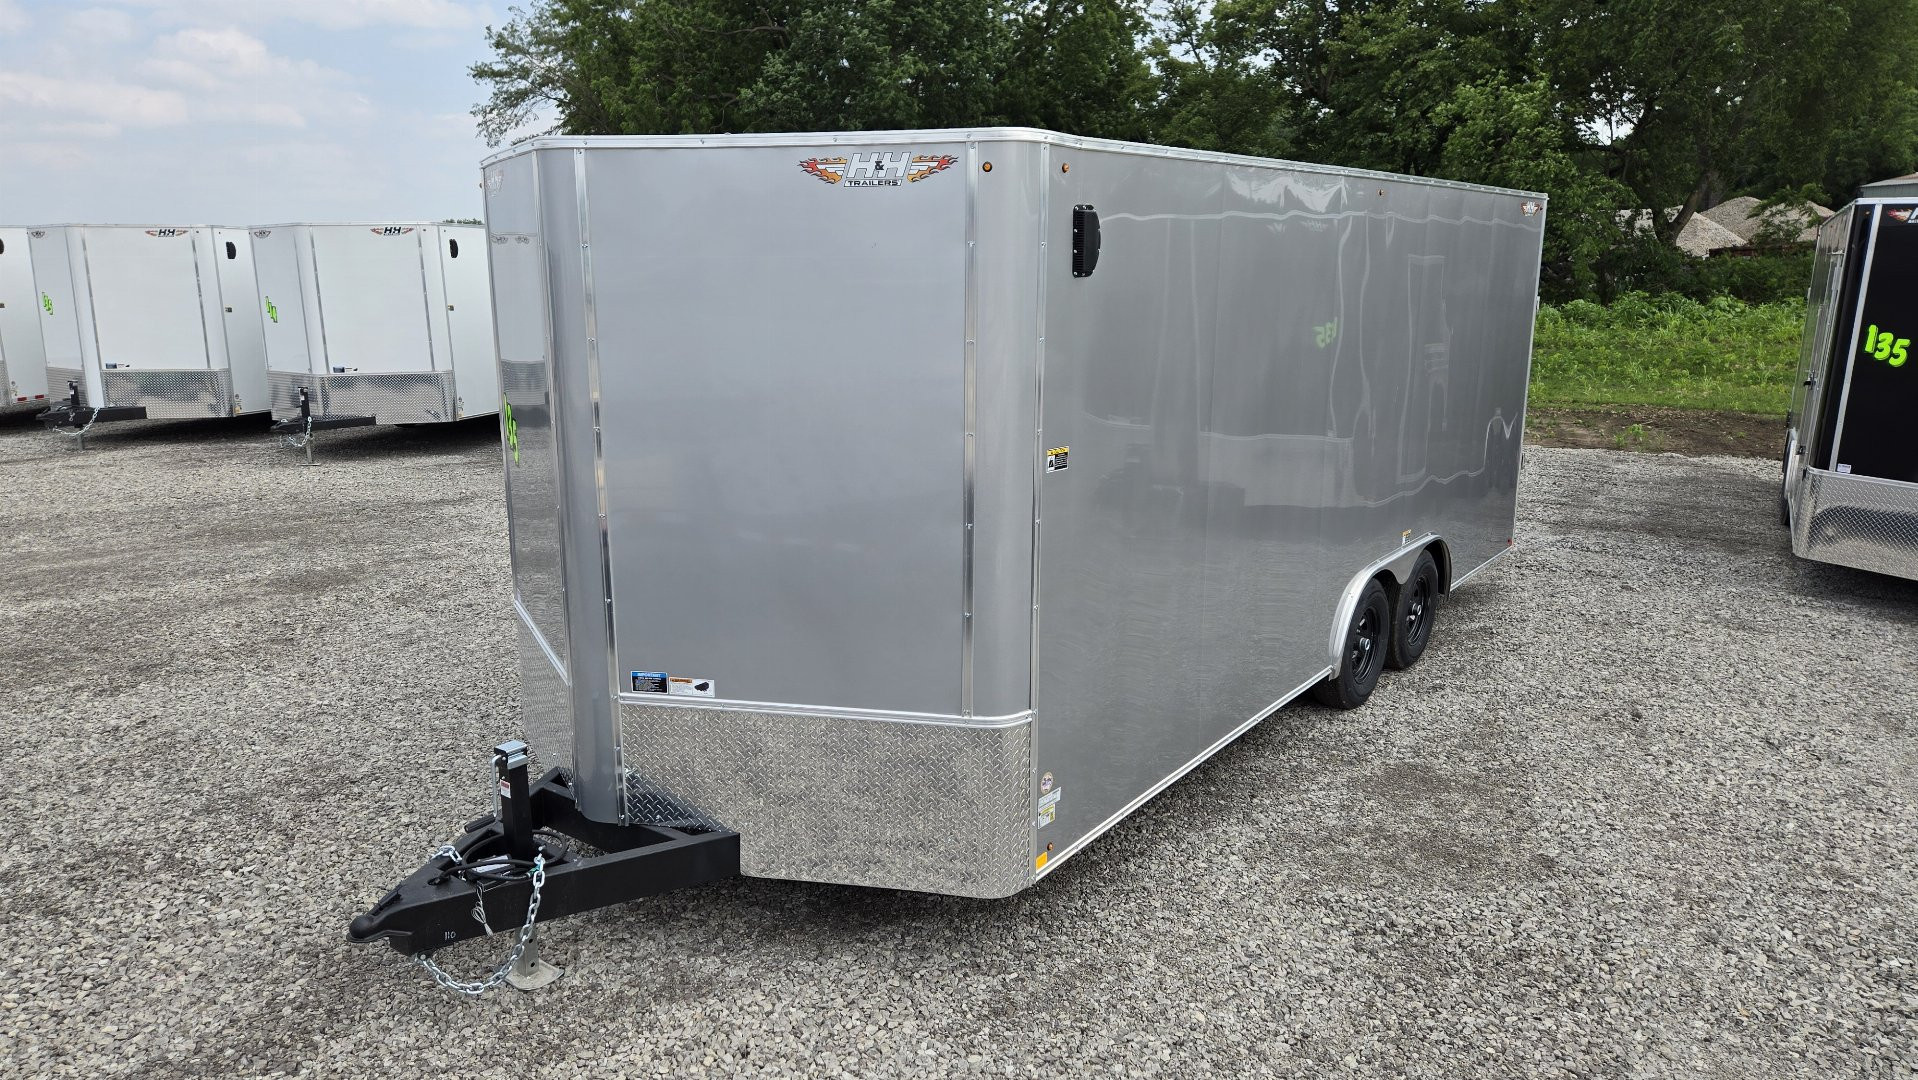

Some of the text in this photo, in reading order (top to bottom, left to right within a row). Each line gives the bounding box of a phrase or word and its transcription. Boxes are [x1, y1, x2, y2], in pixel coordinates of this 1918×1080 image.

[846, 152, 911, 178] H&H
[847, 179, 900, 187] TRAILERS
[1864, 324, 1911, 368] 135
